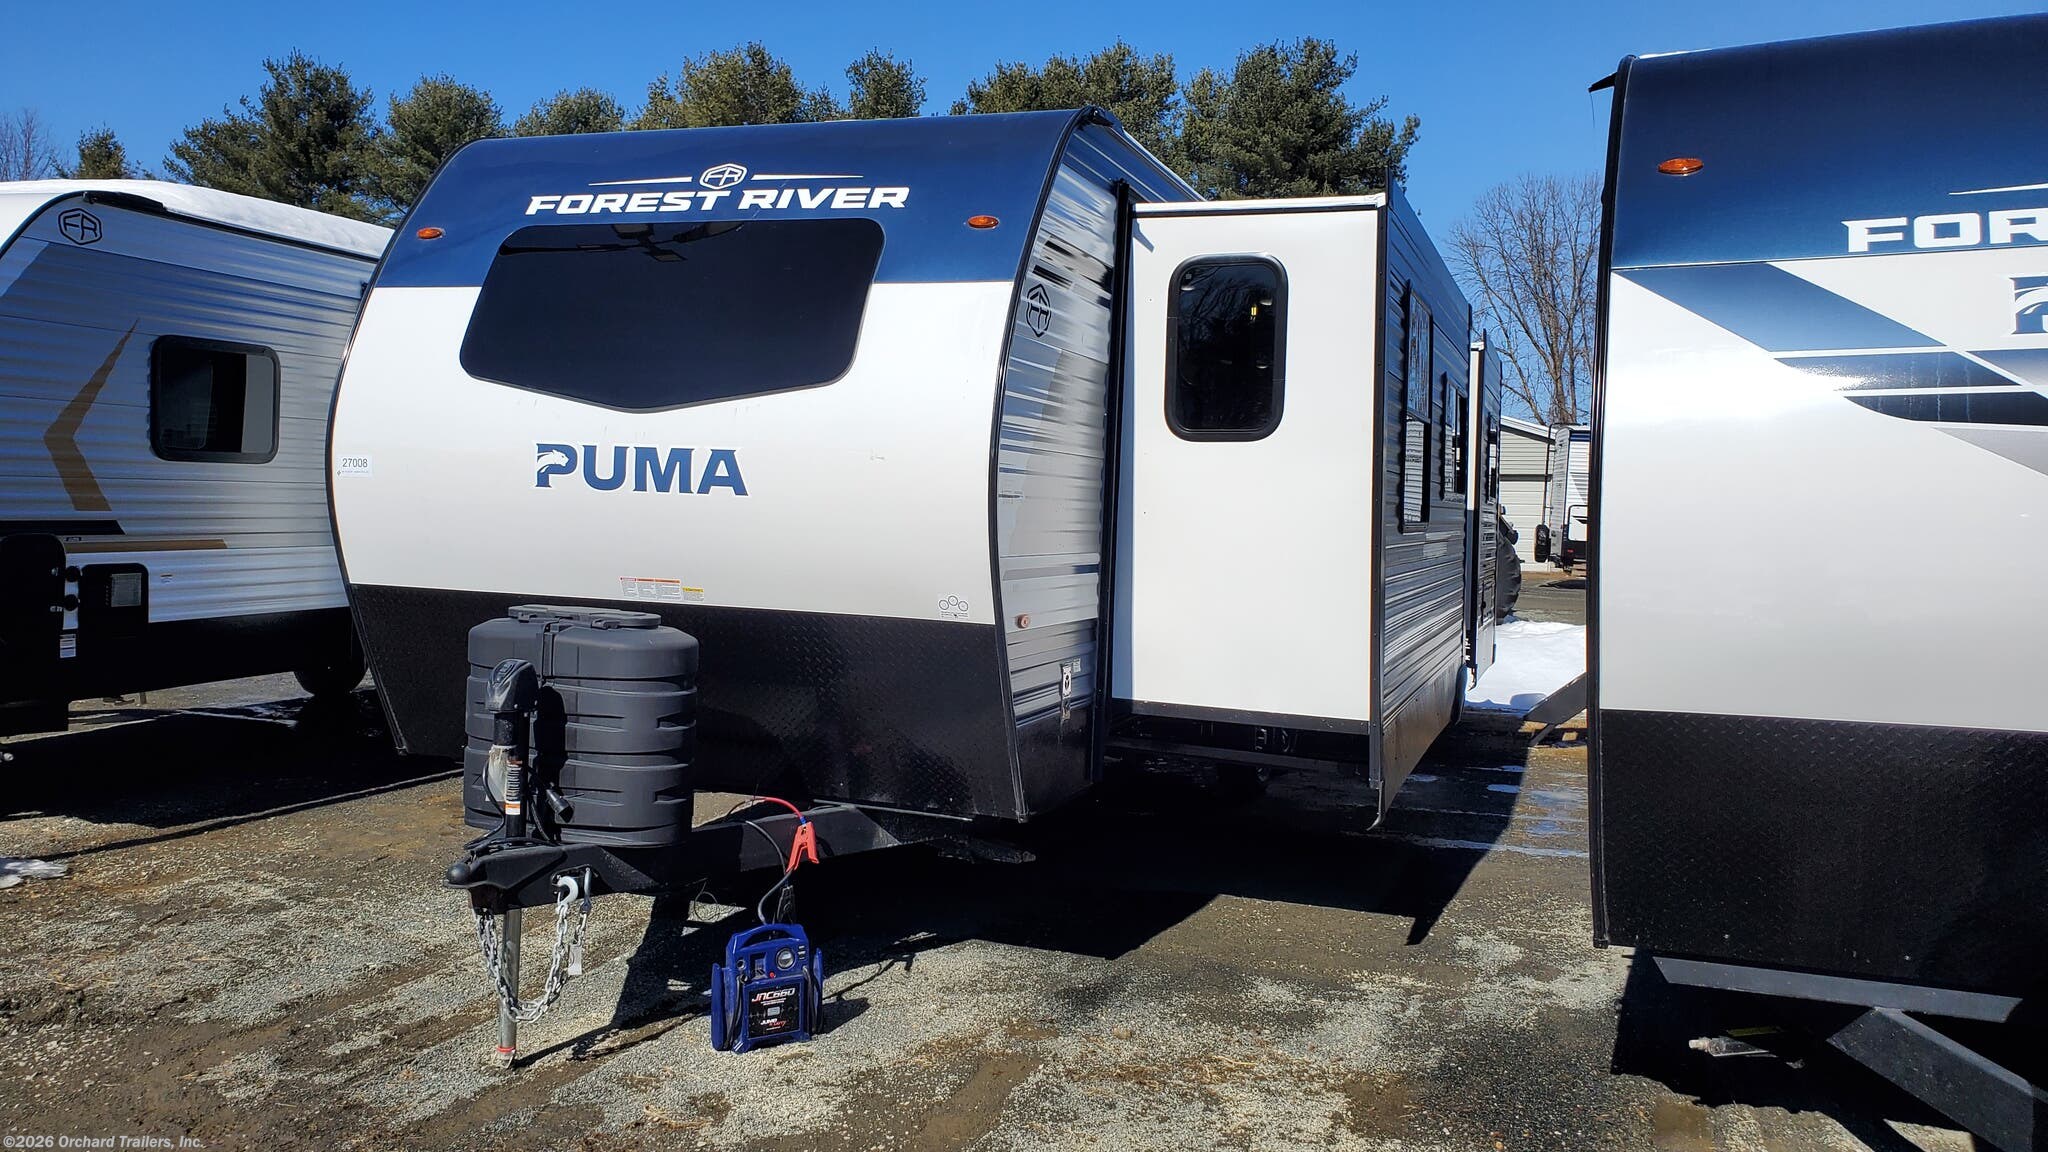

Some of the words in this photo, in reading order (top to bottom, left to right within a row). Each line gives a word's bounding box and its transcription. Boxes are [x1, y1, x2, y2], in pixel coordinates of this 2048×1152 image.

[525, 190, 731, 216] FOREST
[737, 187, 910, 210] RIVER
[342, 457, 368, 468] 27008
[535, 443, 749, 496] PUMA
